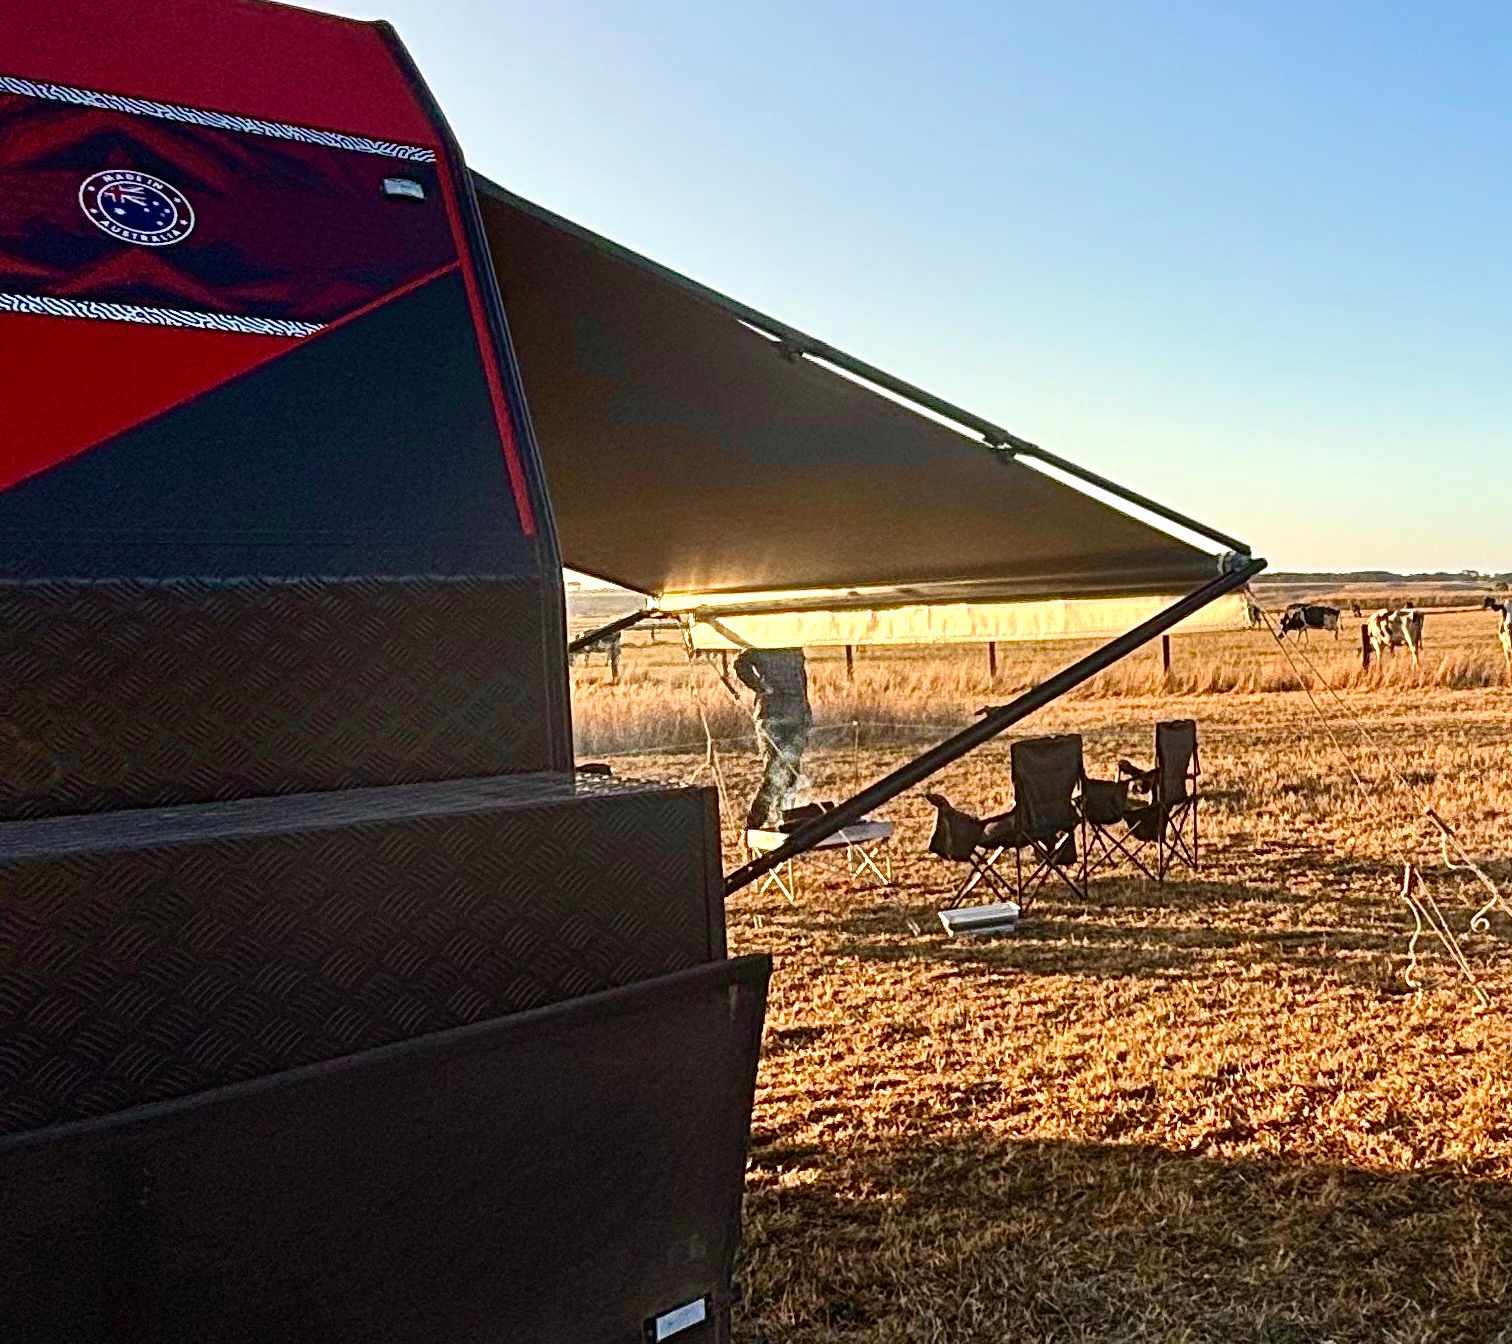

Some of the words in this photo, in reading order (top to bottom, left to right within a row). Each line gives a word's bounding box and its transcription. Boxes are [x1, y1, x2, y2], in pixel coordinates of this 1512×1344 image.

[103, 173, 142, 183] MADE
[147, 179, 164, 190] IN
[99, 220, 182, 242] AUSTRALIA
